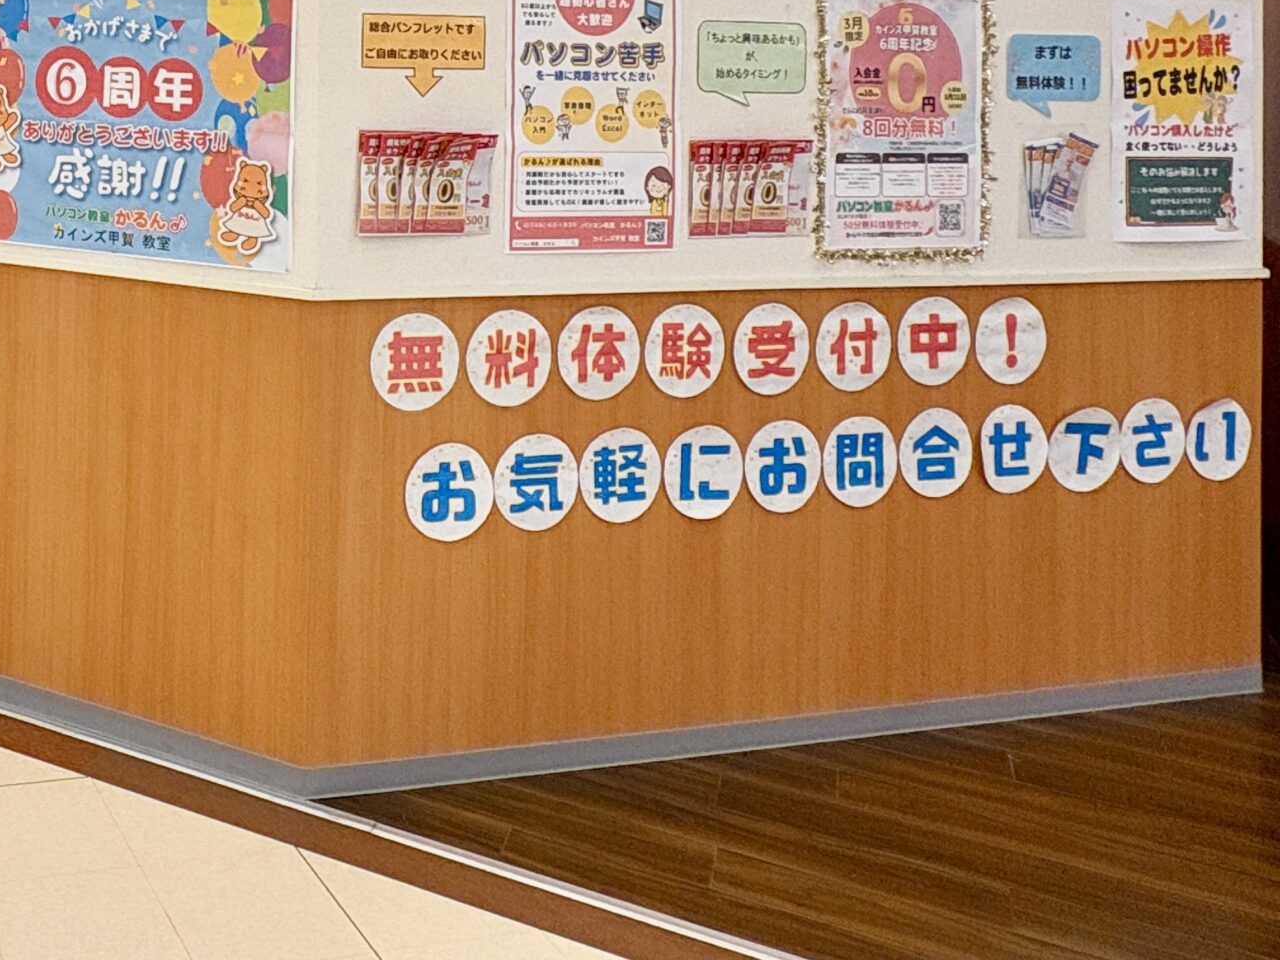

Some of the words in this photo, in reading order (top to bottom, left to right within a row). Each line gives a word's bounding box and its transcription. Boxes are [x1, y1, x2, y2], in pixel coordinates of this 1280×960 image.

[577, 13, 614, 26] 大歓迎
[843, 16, 863, 30] 3月
[66, 16, 178, 52] おかげさまで
[369, 21, 475, 35] 総合パンフレットです
[1034, 45, 1072, 60] まずは
[1125, 33, 1232, 60] パソコン操作
[365, 47, 482, 62] ご自由にお取りください
[520, 40, 666, 70] パソコン苦手
[536, 70, 656, 82] を一緒に克服させてください
[715, 68, 789, 80] 始めるタイミング!
[853, 67, 881, 79] 入会金
[46, 58, 194, 112] 6周年
[1015, 76, 1088, 91] 無料体験!!
[1123, 65, 1240, 100] 困ってませんか?
[524, 115, 554, 124] パソコン
[532, 125, 546, 134] 入門
[601, 124, 623, 132] Excel
[862, 118, 957, 139] 8回分無料!
[22, 121, 228, 153] ありがとうございます!!
[48, 147, 186, 201] 感謝!!
[53, 226, 134, 249] カインズ甲賀
[142, 235, 171, 251] 教室
[385, 311, 1017, 394] 無料体験受付中!
[419, 410, 1238, 523] お気軽にお問合せ下さい
